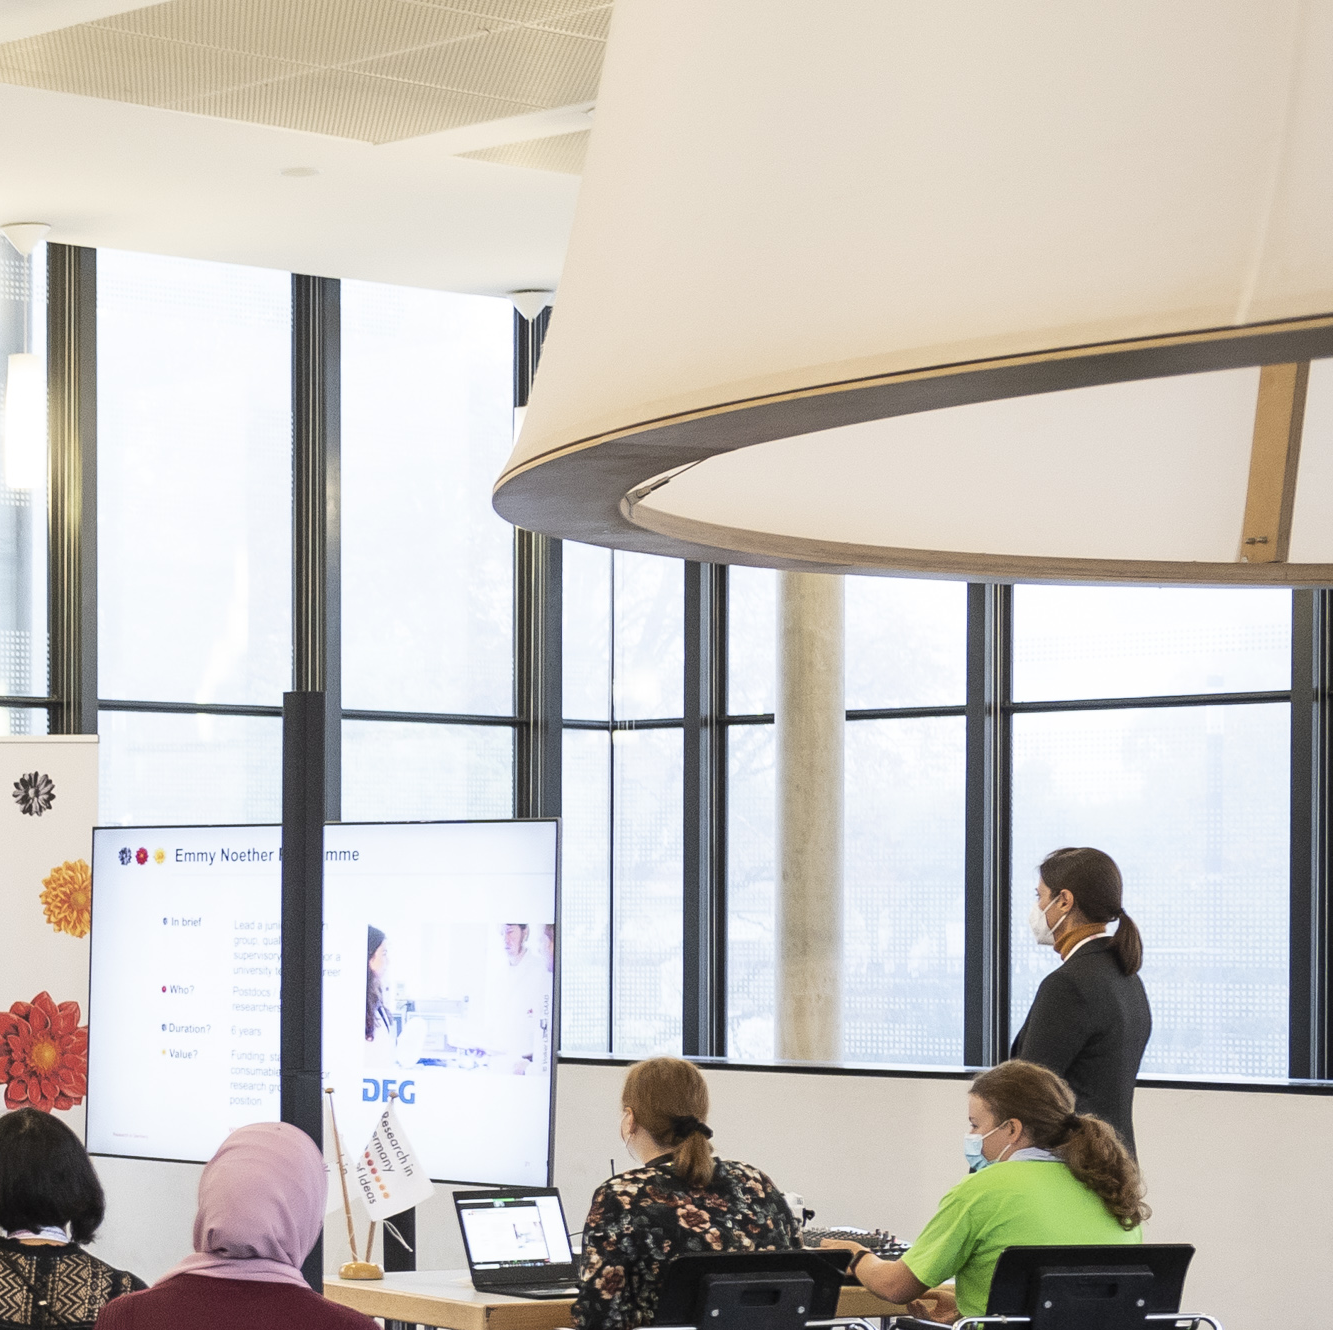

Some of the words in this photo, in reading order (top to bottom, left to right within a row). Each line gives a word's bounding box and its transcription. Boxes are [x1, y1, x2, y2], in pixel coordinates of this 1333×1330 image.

[175, 848, 216, 866] Emmy
[221, 847, 273, 862] Noether
[171, 917, 180, 927] In
[182, 916, 202, 927] brief
[234, 920, 255, 930] Lead
[264, 920, 282, 932] juni
[233, 965, 272, 978] university
[169, 985, 195, 995] Who?
[233, 986, 271, 997] Postdocs
[232, 1003, 282, 1013] researchers
[168, 1023, 212, 1035] Duration?
[239, 1027, 262, 1038] years
[169, 1049, 198, 1060] Value?
[230, 1066, 282, 1077] consumable
[230, 1081, 266, 1091] research
[362, 1078, 416, 1104] DFG
[229, 1096, 262, 1106] position
[372, 1130, 395, 1172] ermany
[403, 1164, 414, 1178] in
[358, 1173, 378, 1204] Ideas
